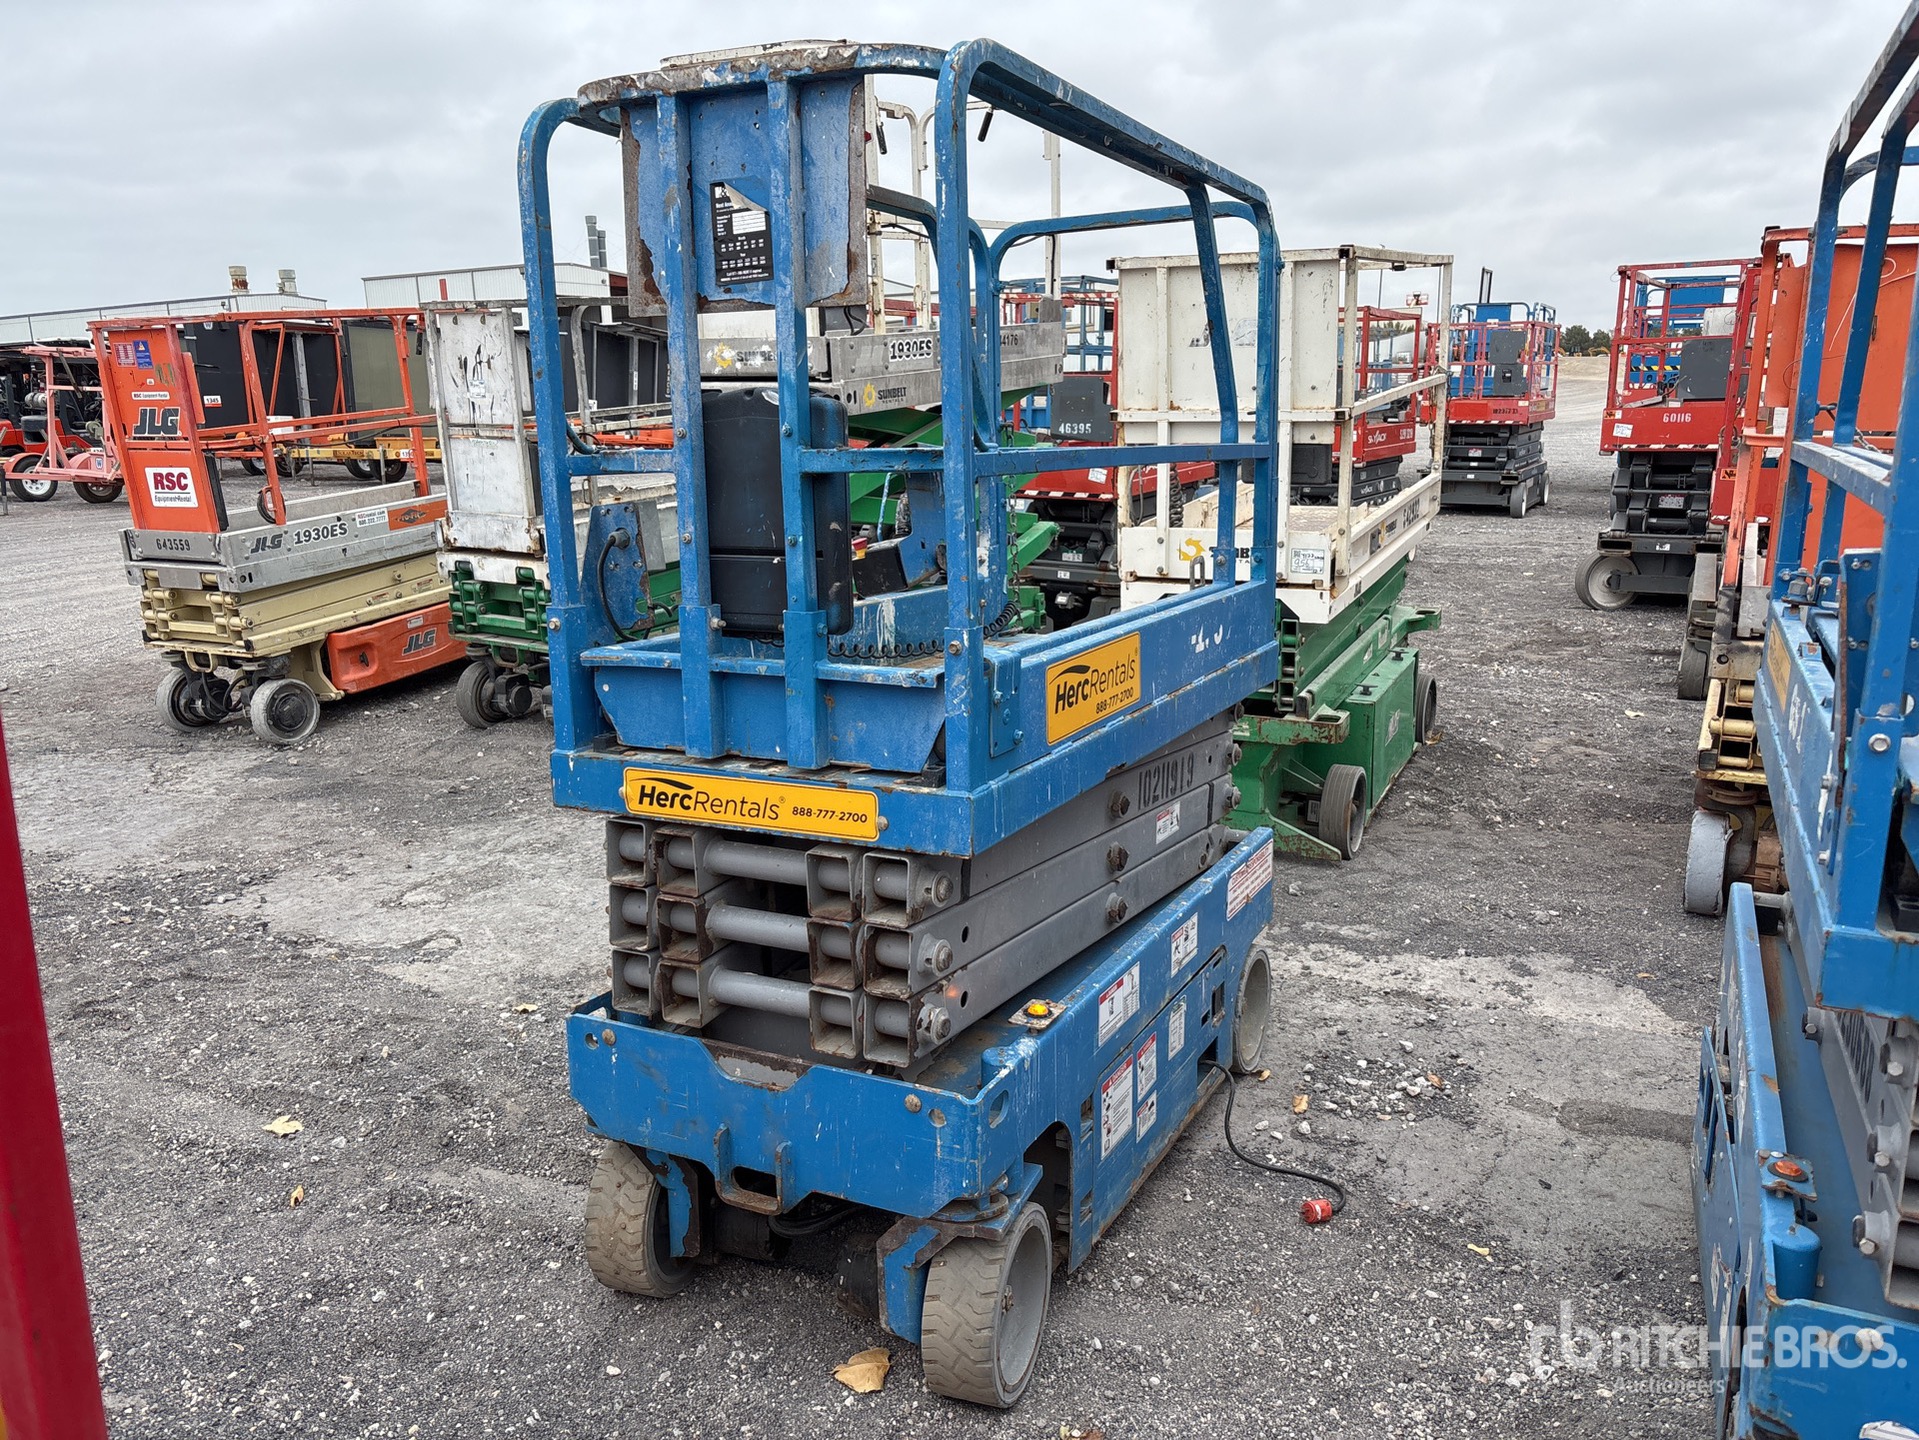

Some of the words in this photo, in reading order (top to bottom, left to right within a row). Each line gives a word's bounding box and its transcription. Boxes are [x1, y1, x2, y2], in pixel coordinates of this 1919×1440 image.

[878, 386, 907, 399] SUNBELT
[133, 407, 181, 436] JLG
[1058, 423, 1092, 434] 46395
[153, 472, 189, 491] RSC
[250, 533, 284, 554] JLG
[294, 522, 348, 545] 1930ES
[156, 538, 191, 551] 643559
[402, 628, 437, 655] JLG
[1095, 686, 1134, 715] 888-777-2700
[792, 806, 868, 824] 888-777-2700
